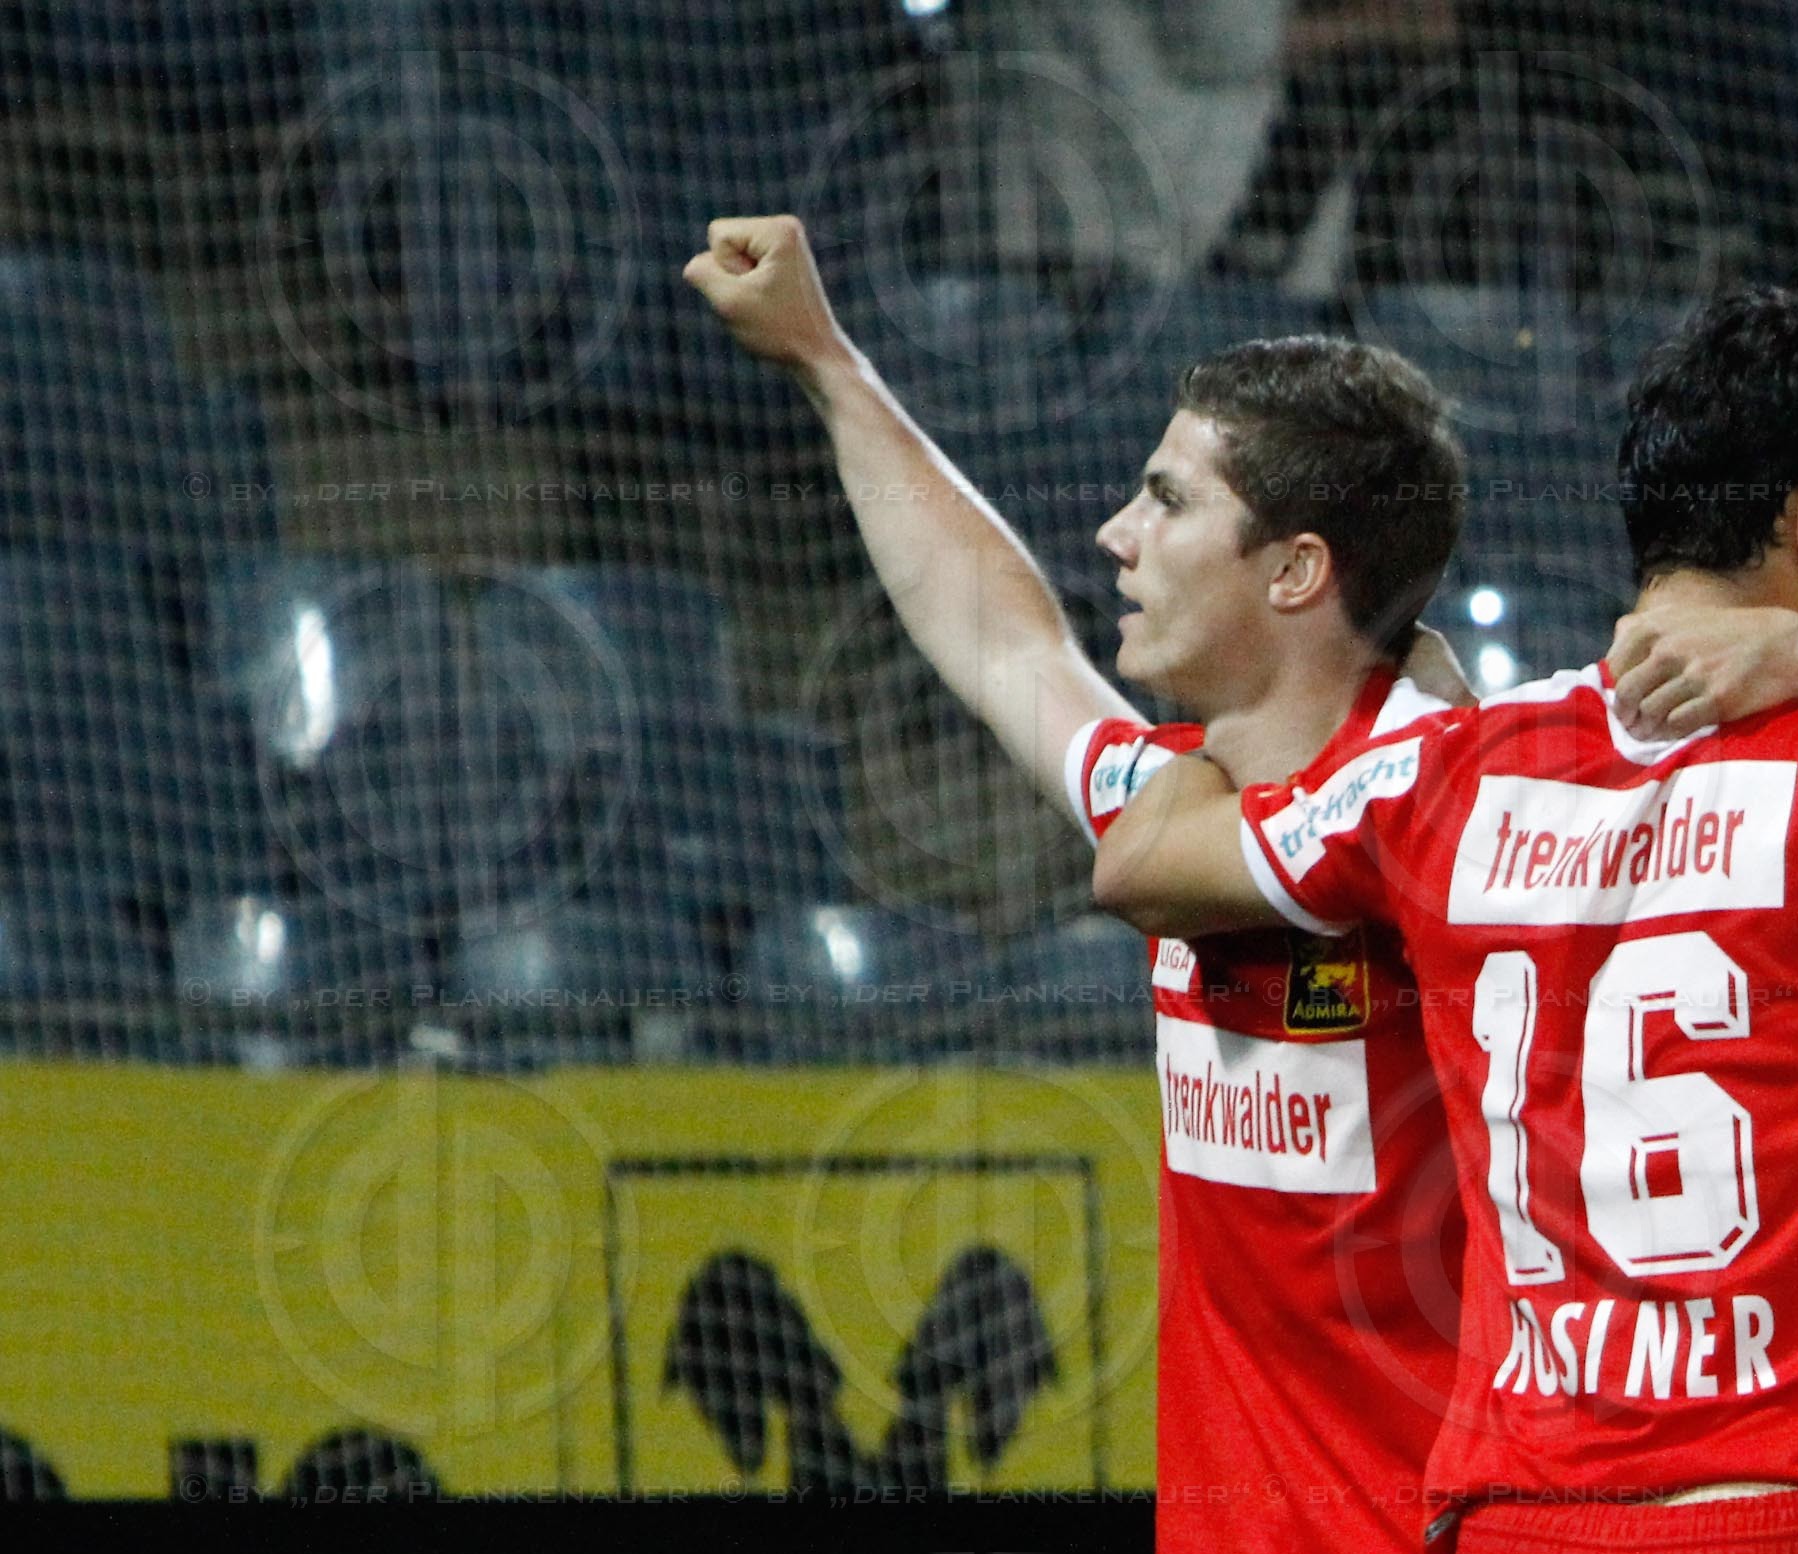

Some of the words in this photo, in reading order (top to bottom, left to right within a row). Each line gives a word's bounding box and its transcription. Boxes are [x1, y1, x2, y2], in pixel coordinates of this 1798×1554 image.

[1292, 1000, 1362, 1021] ADMIRA
[1166, 1052, 1333, 1164] trenkwalder
[1472, 930, 1760, 1287] 16
